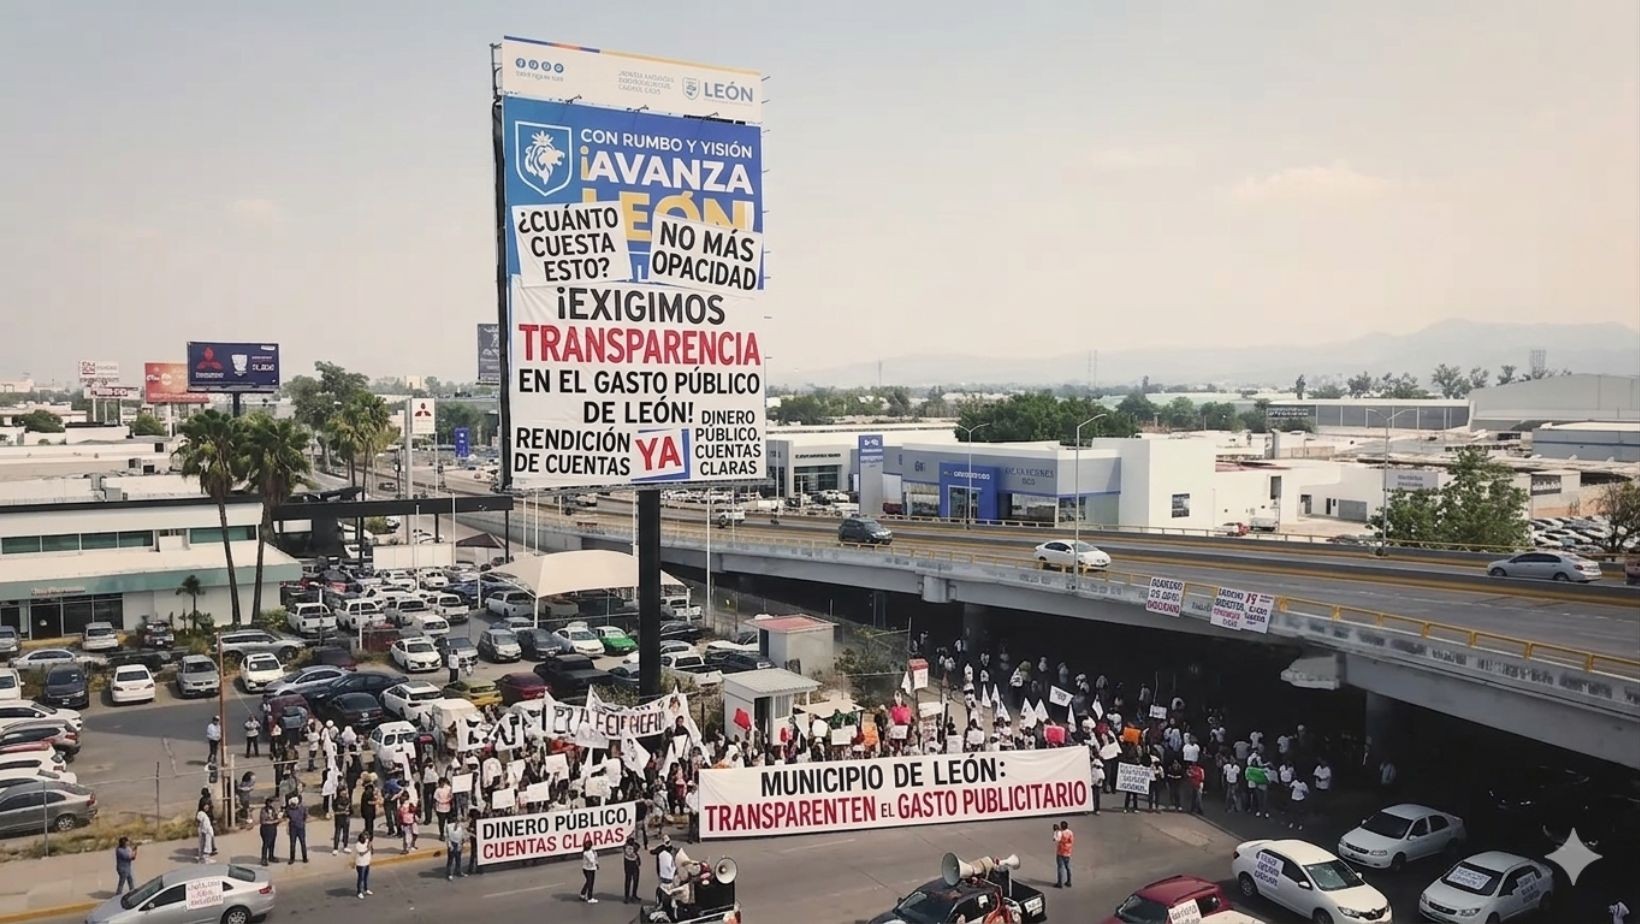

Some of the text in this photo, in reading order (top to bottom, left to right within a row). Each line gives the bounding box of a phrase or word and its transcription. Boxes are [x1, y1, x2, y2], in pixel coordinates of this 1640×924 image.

[704, 81, 753, 102] LEÓN
[580, 128, 618, 145] CON
[623, 132, 682, 151] RUMBO
[685, 140, 697, 154] Y
[518, 204, 618, 233] ¿CUÁNTO
[531, 232, 615, 257] CUESTA
[660, 221, 754, 262] NO MÁS
[544, 258, 610, 282] ESTO?
[652, 250, 756, 290] OPACIDAD
[556, 287, 725, 325] ¡EXIGIMOS
[519, 324, 760, 366] TRANSPARENCIA
[519, 366, 760, 394] EN EL GASTO PÚBLICO
[584, 396, 693, 423] DE LEÓN!
[702, 410, 755, 425] DINERO
[516, 427, 630, 452] RENDICIÓN
[695, 424, 761, 442] PÚBLICO,
[514, 453, 630, 476] DE CUENTAS
[634, 435, 682, 471] YA
[695, 443, 762, 459] CUENTAS
[699, 460, 758, 476] CLARAS
[761, 754, 1006, 797] MUNICIPIO DE LEÓN:
[705, 780, 1086, 832] TRANSPARENTEN EL GASTO PUBLICITARIO
[483, 806, 632, 840] DINERO PÚBLICO,
[483, 827, 624, 860] CUENTAS CLARAS
